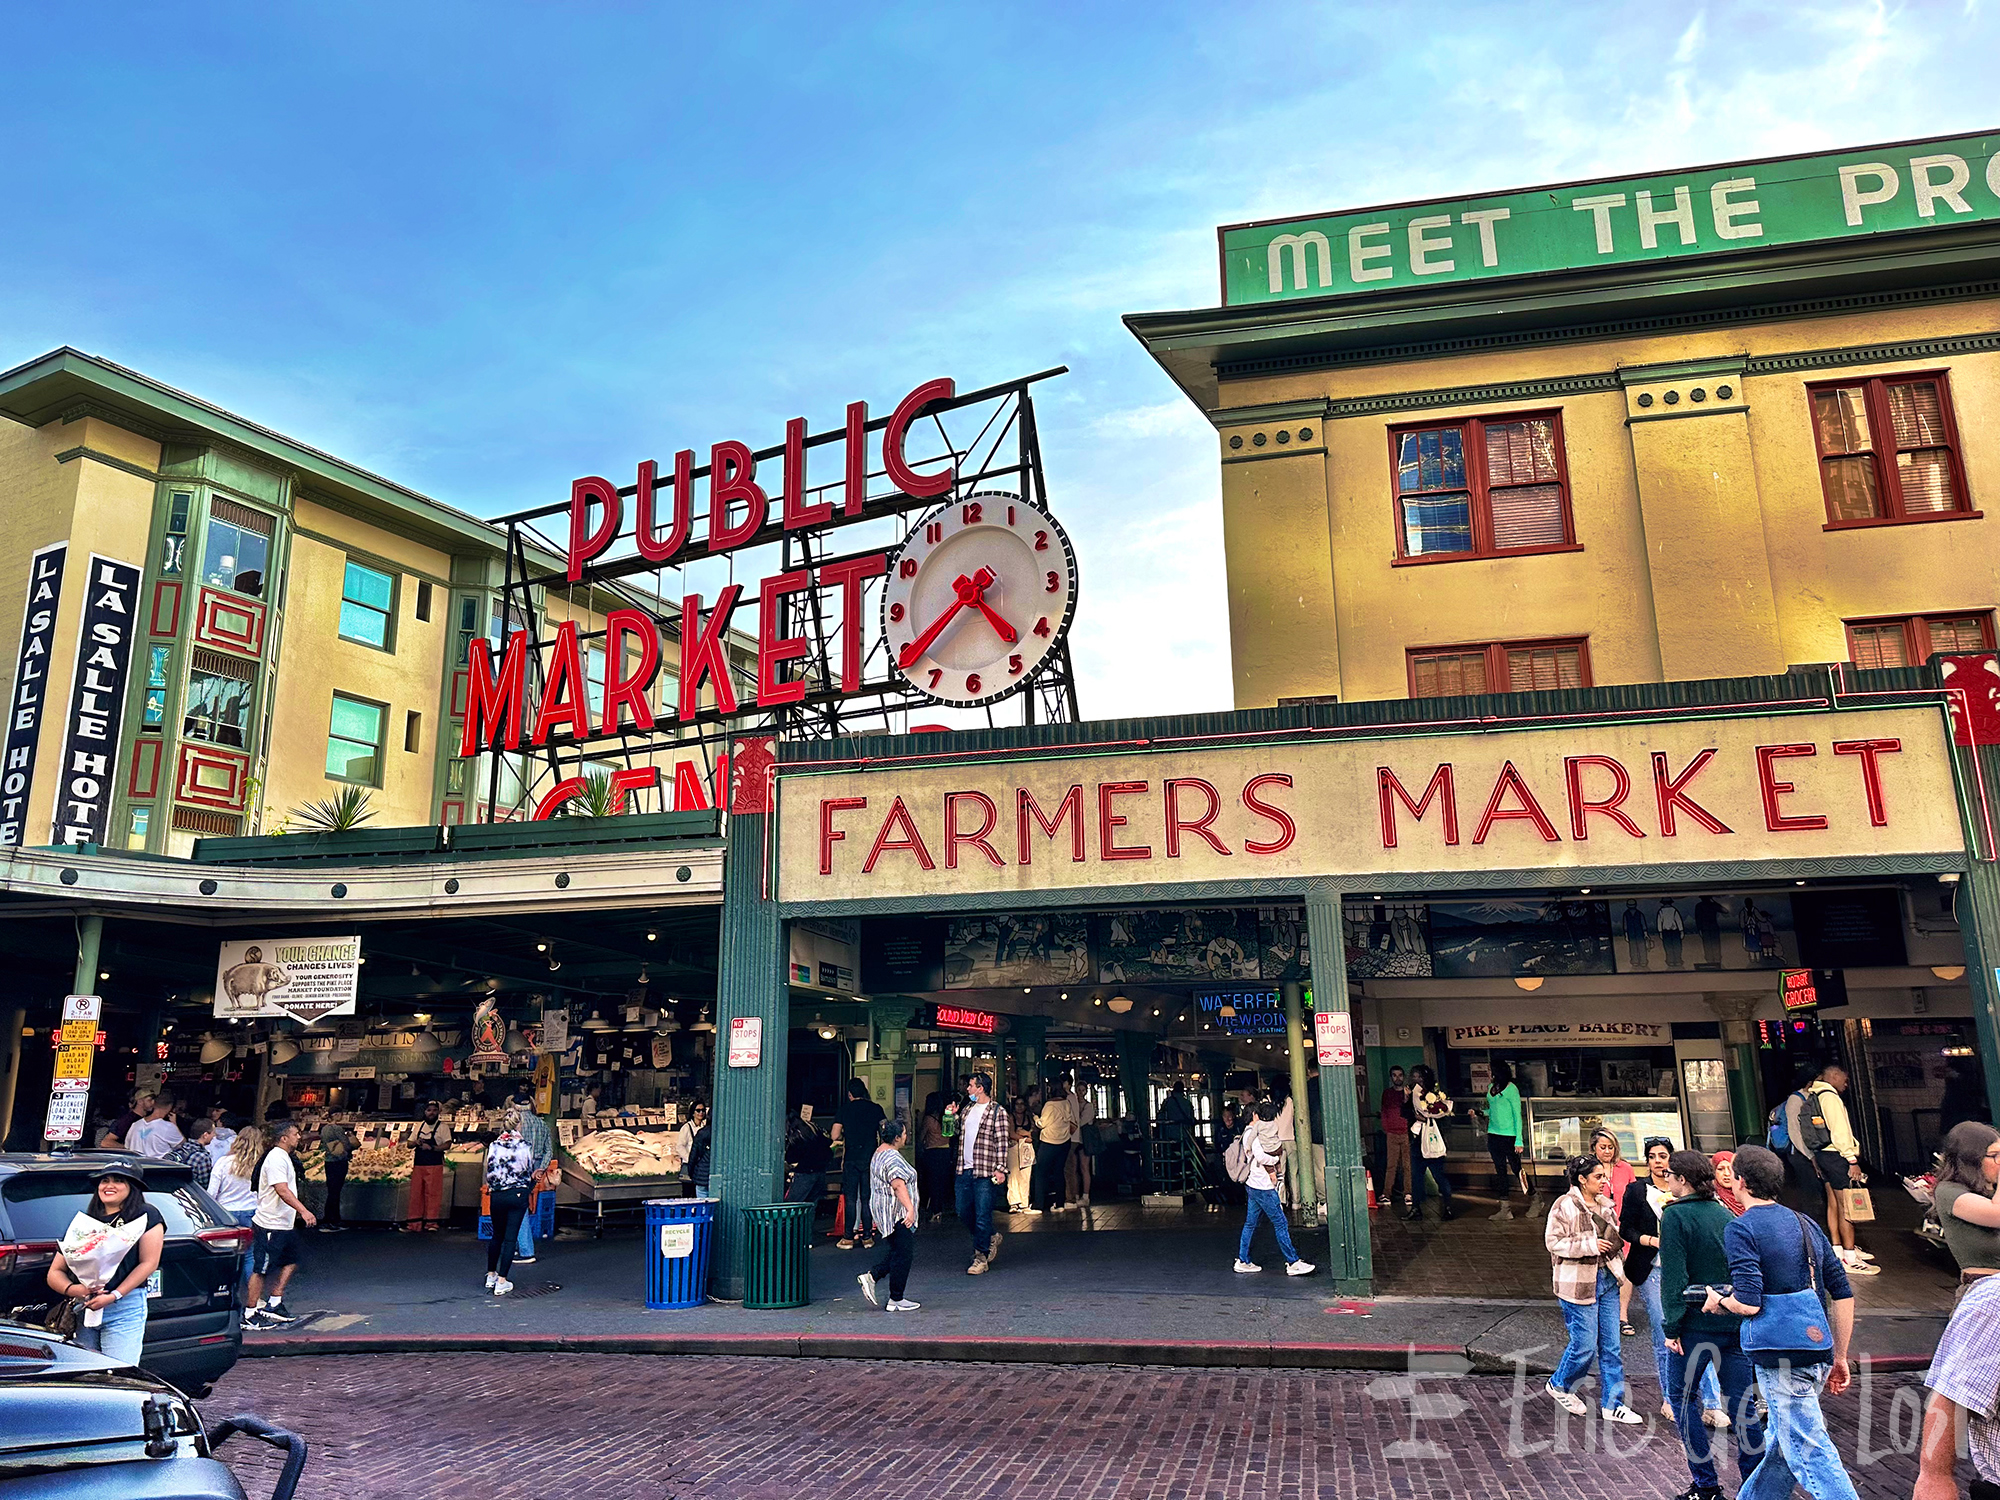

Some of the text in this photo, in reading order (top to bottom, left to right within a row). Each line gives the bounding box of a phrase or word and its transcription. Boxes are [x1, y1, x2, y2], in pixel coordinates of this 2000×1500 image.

[1267, 151, 2000, 294] MEET THE PR
[567, 377, 956, 582] PUBLIC
[962, 502, 983, 525] 12
[926, 522, 942, 544] 11
[1034, 530, 1049, 551] 2
[899, 558, 918, 579] 10
[32, 557, 58, 604] LA
[95, 563, 128, 615] LA
[1045, 571, 1060, 593] 3
[889, 602, 905, 622] 9
[1032, 616, 1050, 638] 4
[460, 552, 887, 757] MARKET
[1008, 654, 1023, 675] 5
[14, 610, 51, 732] SALLE
[76, 623, 121, 741] SALLE
[928, 668, 944, 689] 7
[965, 673, 982, 693] 6
[817, 773, 1297, 876] FARMERS
[1375, 736, 1904, 849] MARKET
[275, 944, 356, 963] YOUR CHANGE
[1785, 987, 1817, 1007] GROCERY
[1321, 1025, 1346, 1034] STOPS
[1454, 1022, 1662, 1039] PIKE PLACE BAKERY
